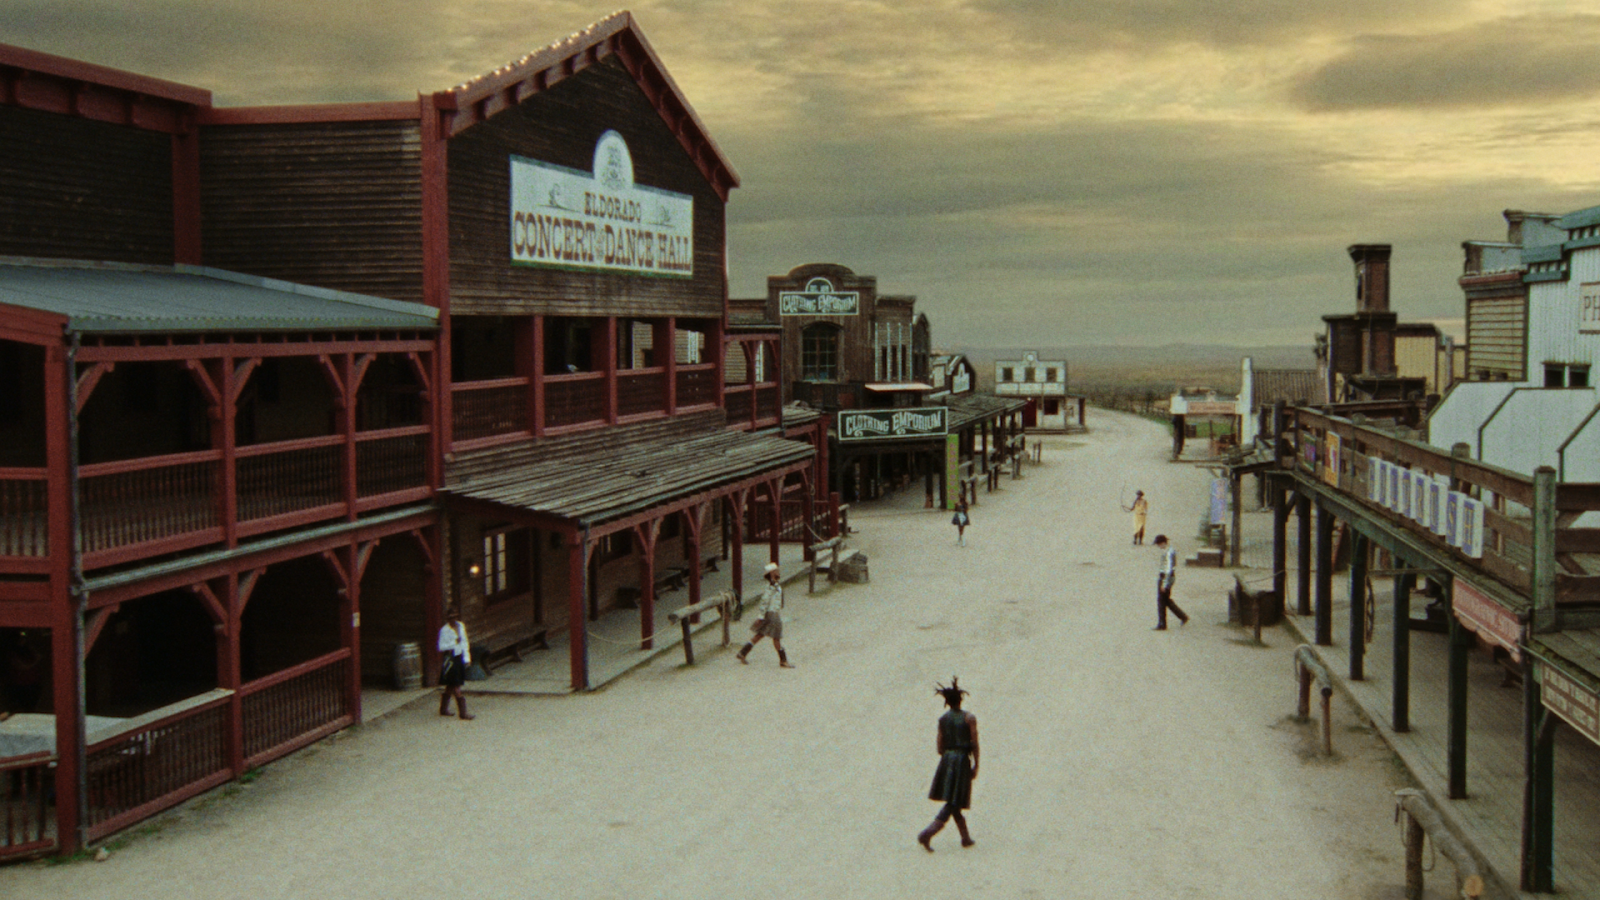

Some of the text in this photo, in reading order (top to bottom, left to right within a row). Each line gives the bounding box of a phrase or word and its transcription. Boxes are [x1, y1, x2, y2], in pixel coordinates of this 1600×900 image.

[584, 191, 641, 223] ELDORADO
[514, 211, 596, 262] CONCERT
[604, 224, 653, 266] DANCE
[657, 233, 691, 271] HALL
[846, 411, 942, 436] CLOTHING EMPORIUM
